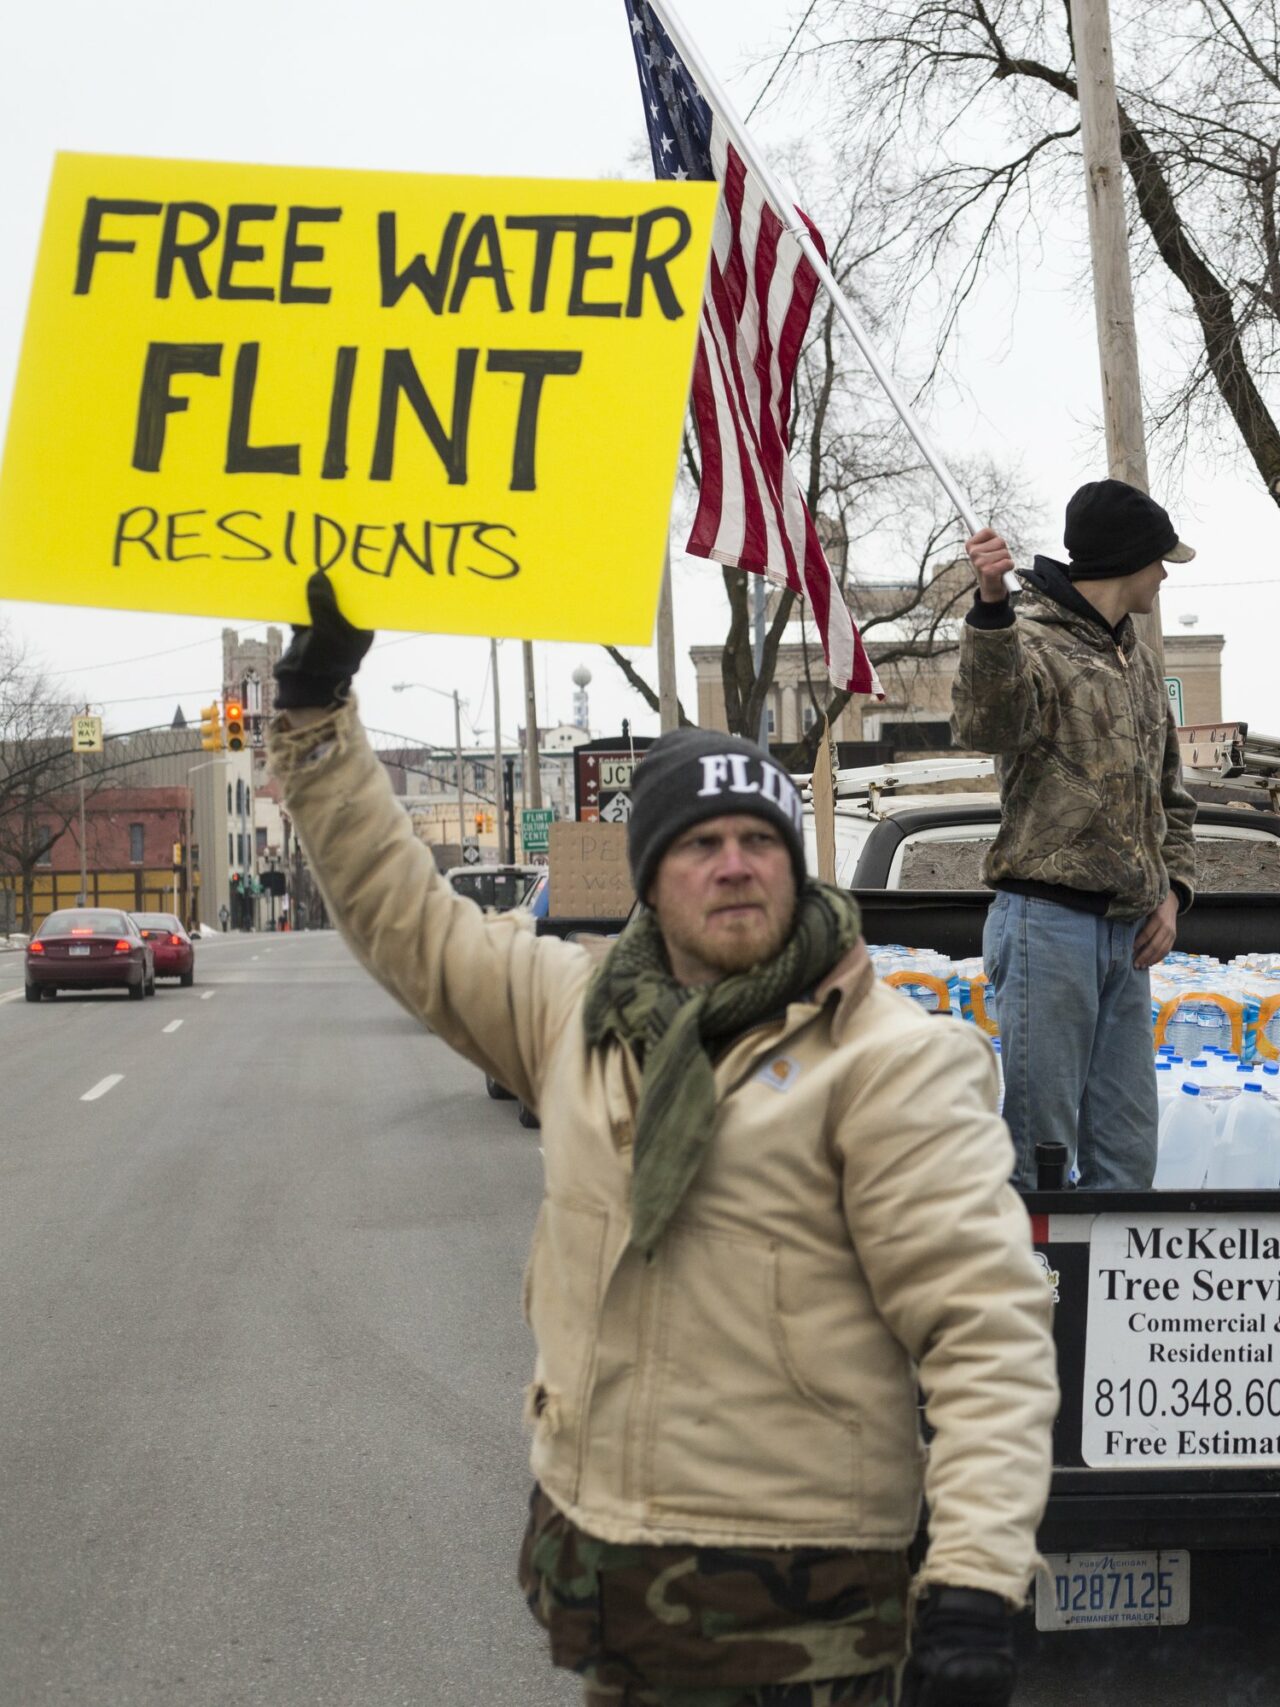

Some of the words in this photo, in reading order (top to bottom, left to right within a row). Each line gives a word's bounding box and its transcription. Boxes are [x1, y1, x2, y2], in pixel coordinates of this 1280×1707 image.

[73, 196, 342, 304] FREE
[377, 206, 692, 321] WATER
[131, 341, 583, 492] FLINT
[112, 506, 520, 579] RESIDENTS
[526, 813, 548, 822] FLINT
[1099, 1269, 1180, 1300] Tree
[1128, 1312, 1266, 1333] Commercial
[1149, 1343, 1274, 1363] Residential
[1104, 1430, 1167, 1456] Free
[1070, 1614, 1119, 1624] PERMANENT
[1121, 1613, 1155, 1622] TRAILER
